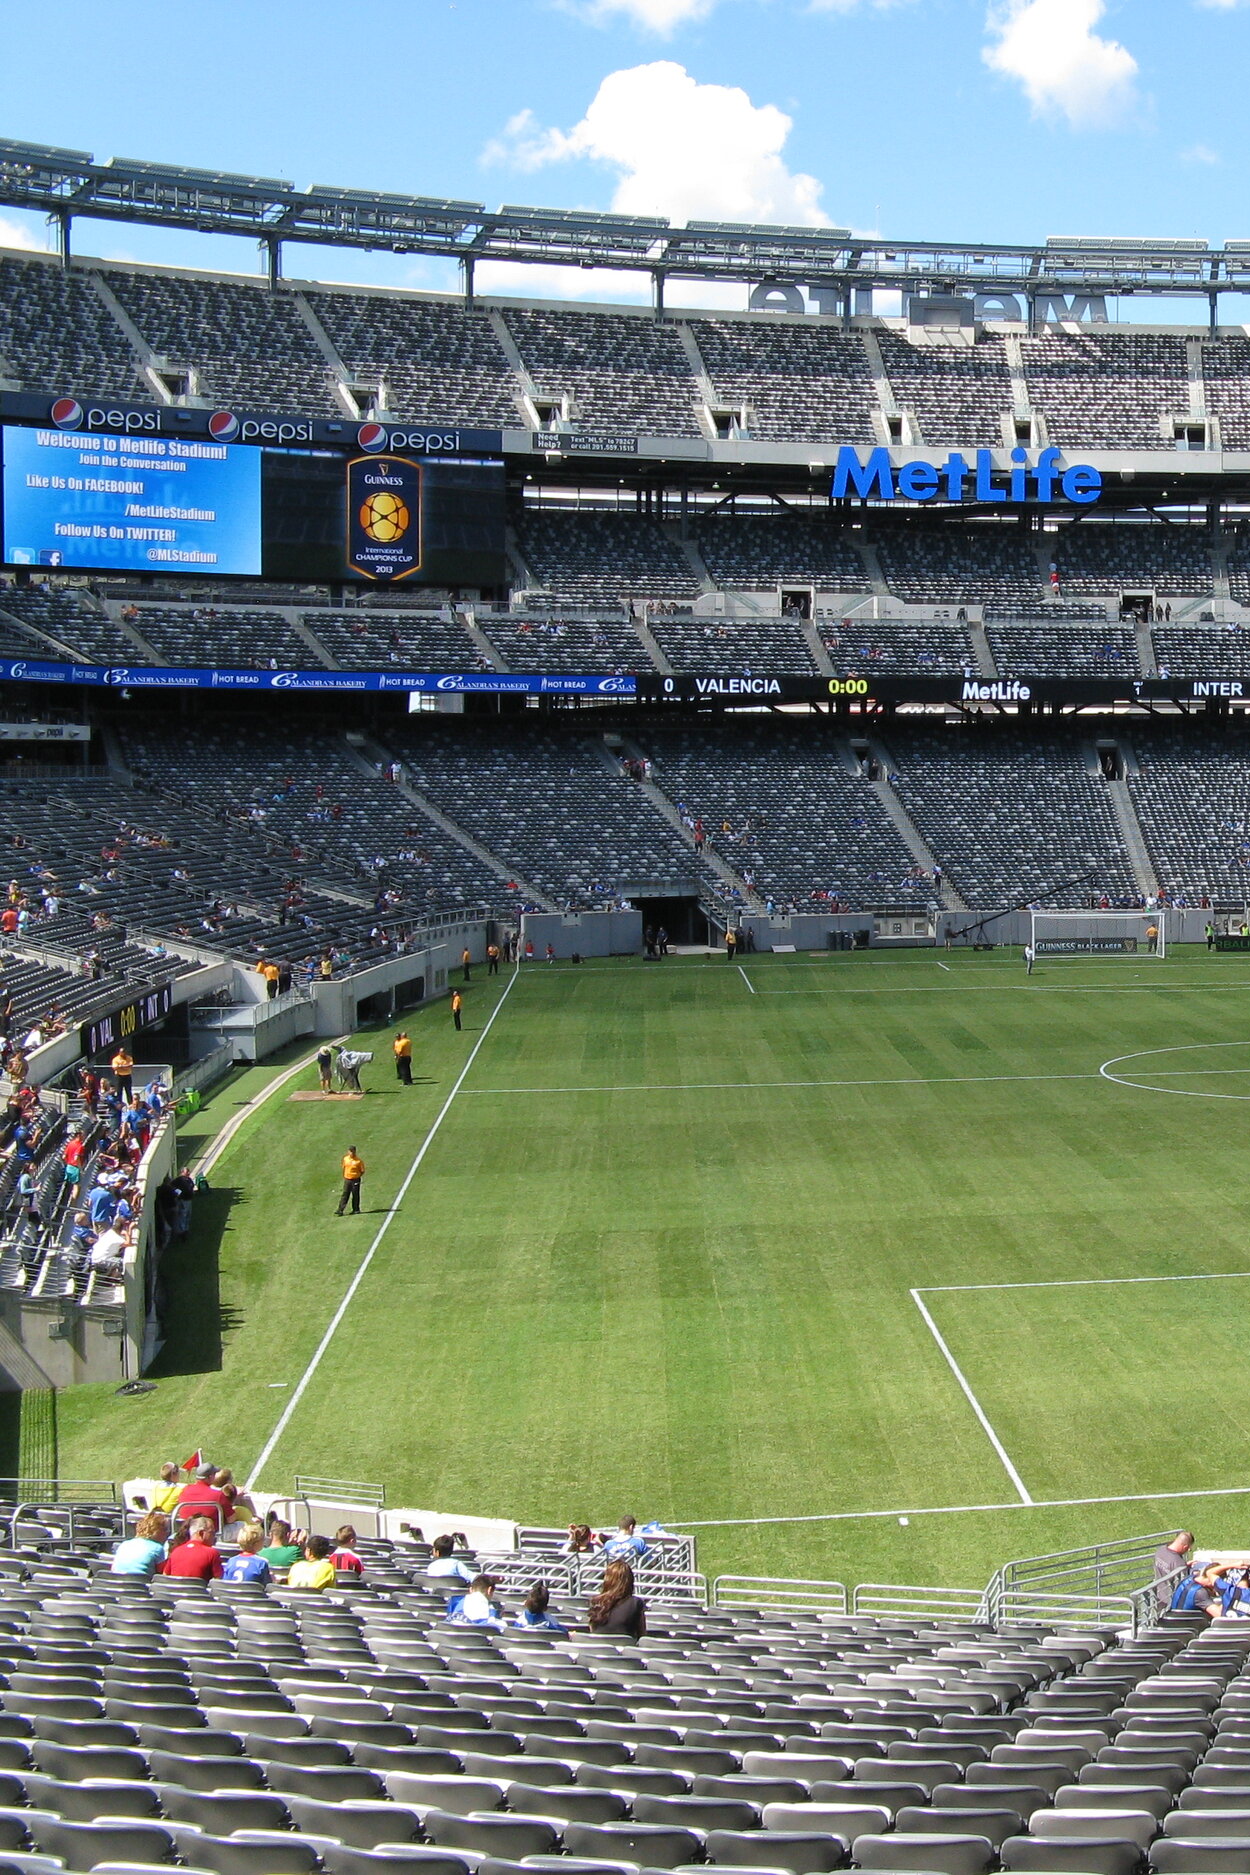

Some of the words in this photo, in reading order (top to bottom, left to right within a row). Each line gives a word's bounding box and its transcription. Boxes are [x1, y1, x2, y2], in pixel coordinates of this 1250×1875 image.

[87, 409, 162, 433] pepsi
[241, 420, 314, 447] pepsi
[537, 433, 559, 441] Need
[36, 431, 101, 451] Welcome
[103, 438, 117, 451] to
[168, 442, 228, 460] Stadium!
[389, 430, 460, 454] pepsi
[537, 440, 562, 449] Help?
[79, 453, 100, 465] Join
[102, 455, 119, 467] the
[120, 456, 187, 472] Conversation
[364, 473, 404, 486] GUINNESS
[831, 445, 1103, 504] MetLife
[26, 473, 49, 488] Like
[51, 475, 66, 489] Us
[68, 476, 83, 490] On
[85, 477, 144, 495] FACEBOOK!
[124, 503, 216, 521] /MetLifeStadium
[54, 523, 91, 538] Follow
[93, 524, 107, 539] Us
[109, 525, 124, 540] On
[126, 526, 176, 542] TWITTER!
[147, 548, 217, 564] @MLStadium
[355, 554, 392, 562] CHAMPIONS
[392, 554, 413, 563] CUP
[364, 546, 404, 555] International
[375, 565, 394, 575] 2013
[218, 675, 235, 684] HOT
[236, 675, 259, 684] BREAD
[386, 678, 401, 687] HOT
[402, 678, 426, 687] BREAD
[547, 681, 562, 689] HOT
[563, 680, 587, 689] BREAD
[664, 678, 674, 692] 0
[695, 678, 781, 694] VALENCIA
[828, 679, 868, 694] 0:00
[962, 680, 1032, 700] MetLife
[1134, 687, 1141, 696] 1
[1193, 682, 1243, 696] INTER
[1035, 941, 1076, 951] GUINNESS
[147, 993, 159, 1021] INT
[163, 989, 169, 1013] 0
[120, 1004, 136, 1038] 0:00
[91, 1026, 97, 1053] 0
[100, 1017, 115, 1048] VAL
